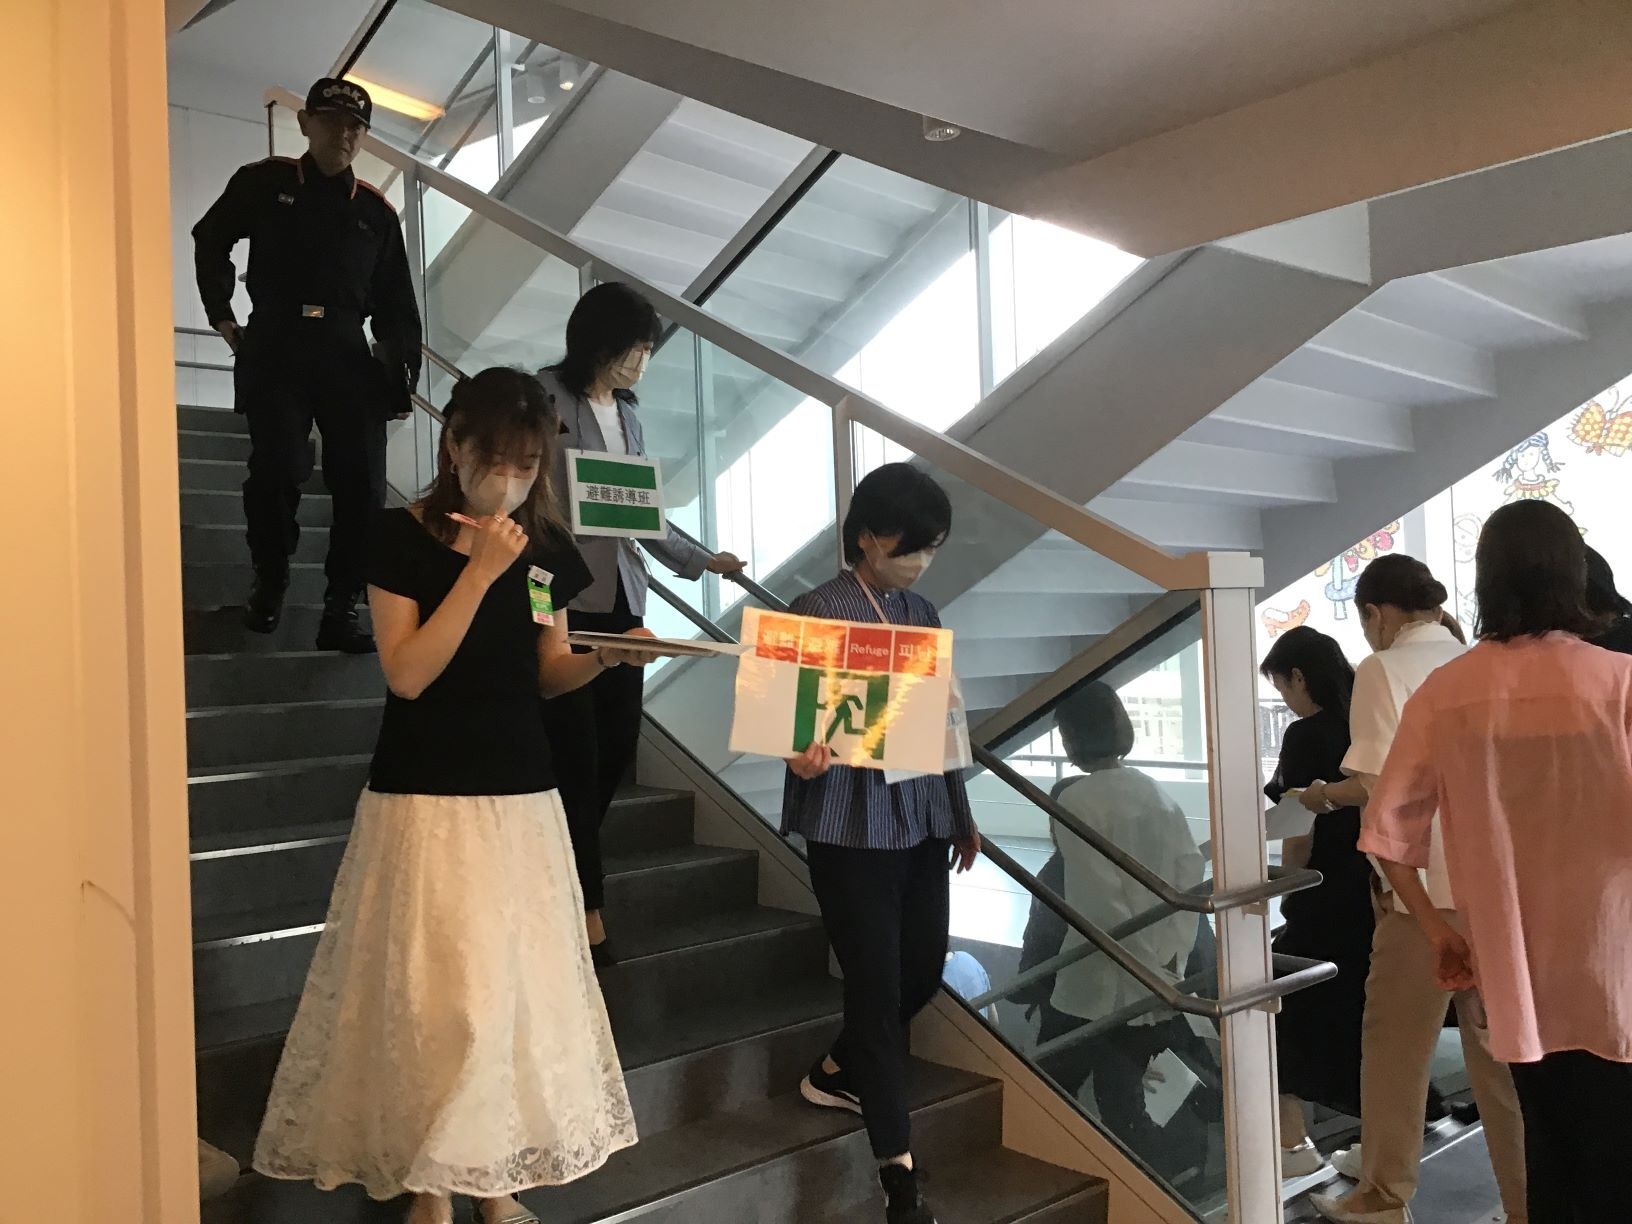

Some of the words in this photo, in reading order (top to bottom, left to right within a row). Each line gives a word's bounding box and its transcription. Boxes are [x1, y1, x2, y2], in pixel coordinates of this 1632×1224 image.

[322, 84, 366, 110] OSAKA
[585, 485, 651, 505] 避難誘導班
[850, 643, 889, 657] Refuge
